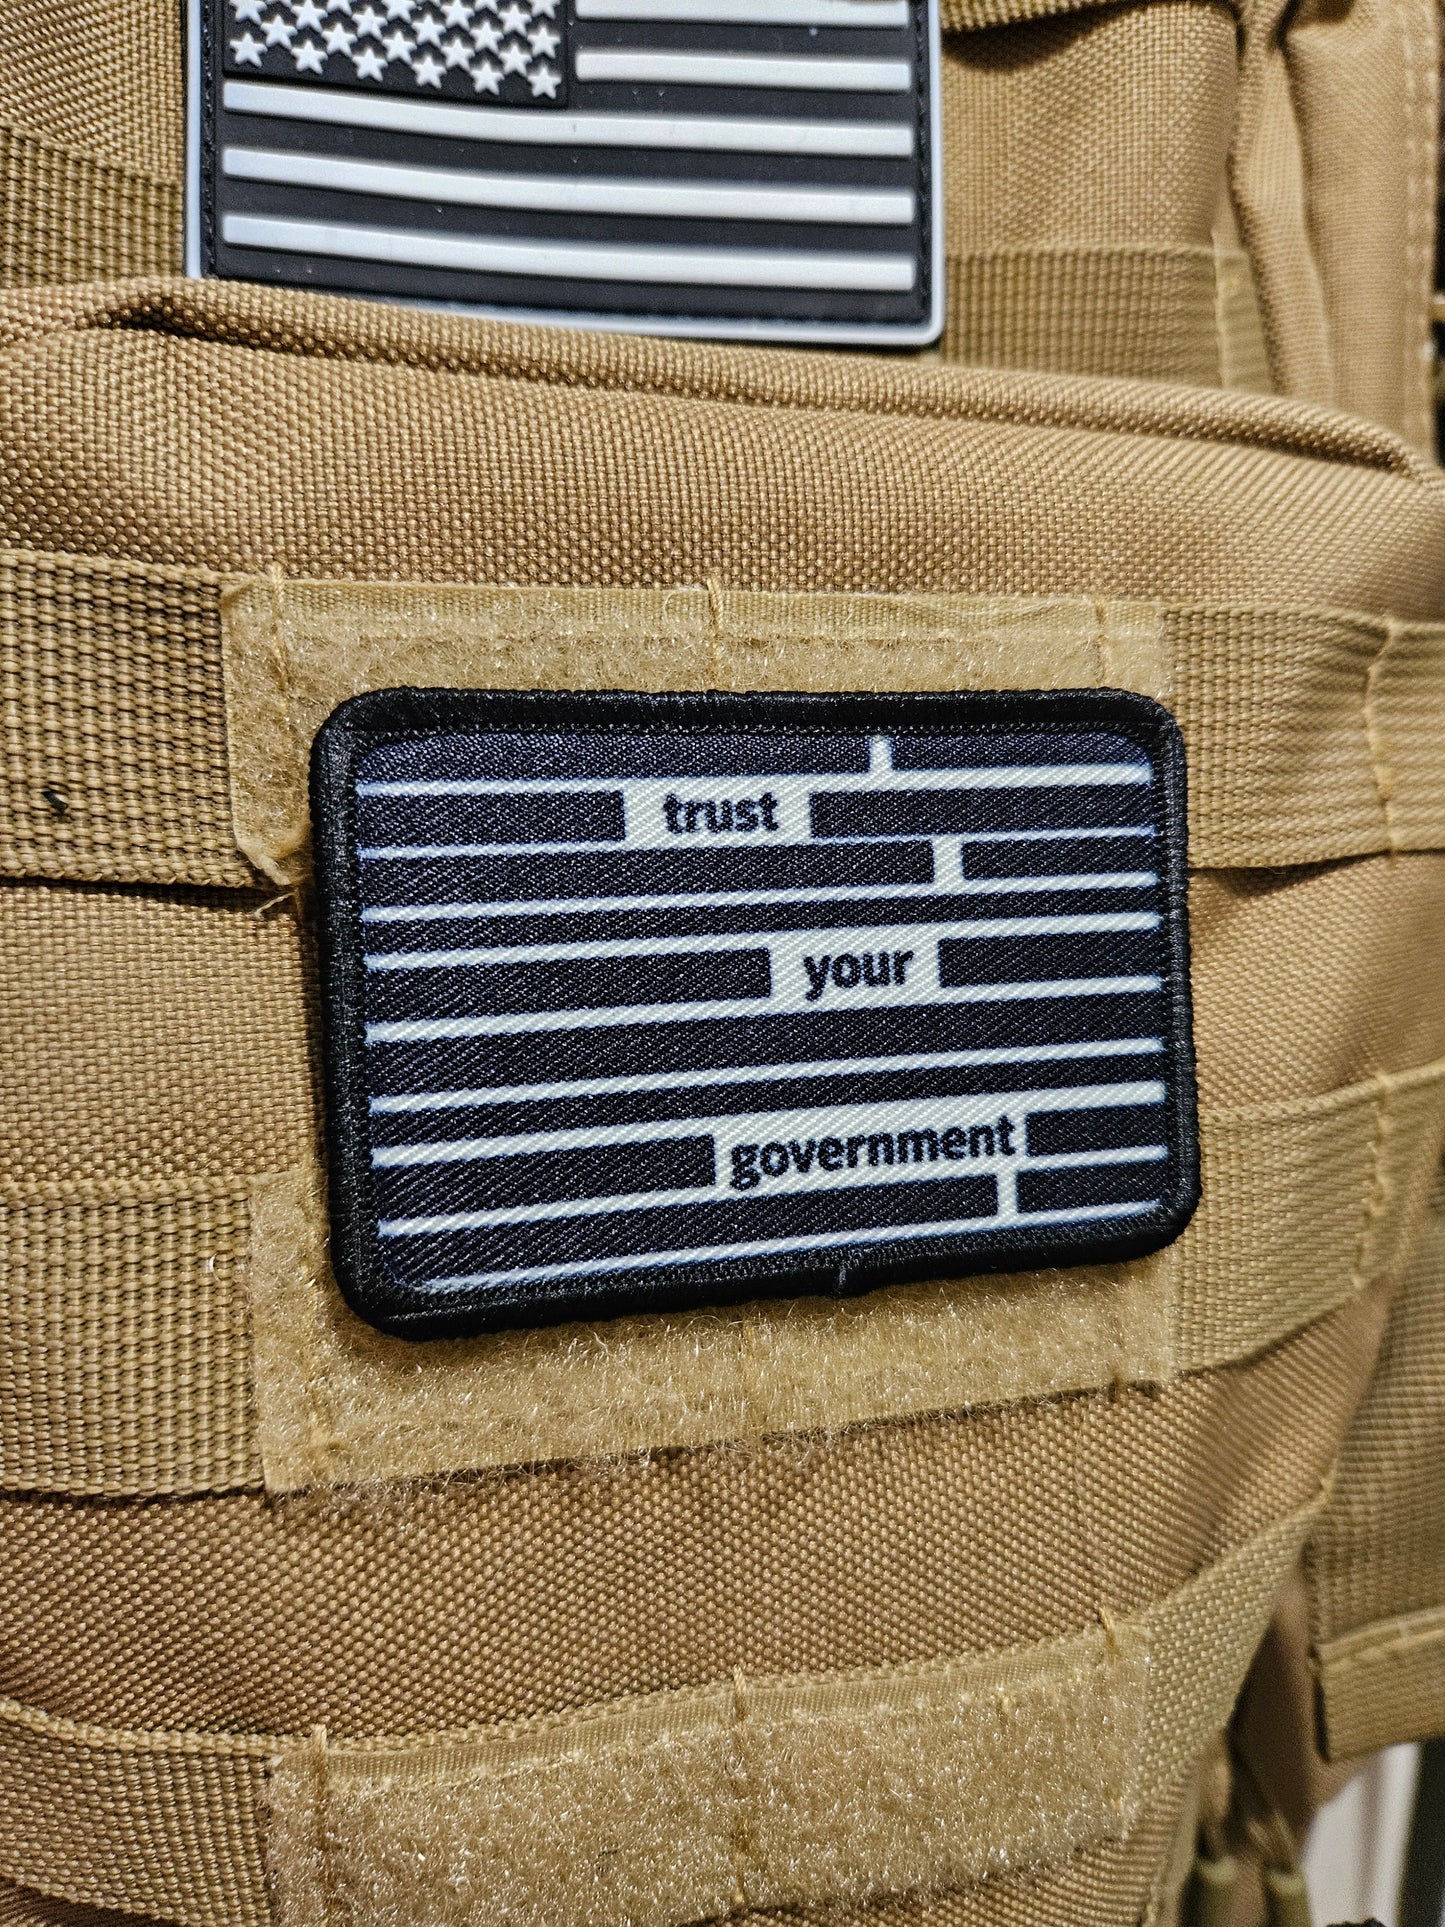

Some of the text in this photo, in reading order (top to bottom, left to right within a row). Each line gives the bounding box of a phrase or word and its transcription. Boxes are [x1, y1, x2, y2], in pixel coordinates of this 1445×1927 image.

[662, 791, 780, 836] trust
[802, 950, 914, 1002] your
[729, 1114, 1017, 1192] government
